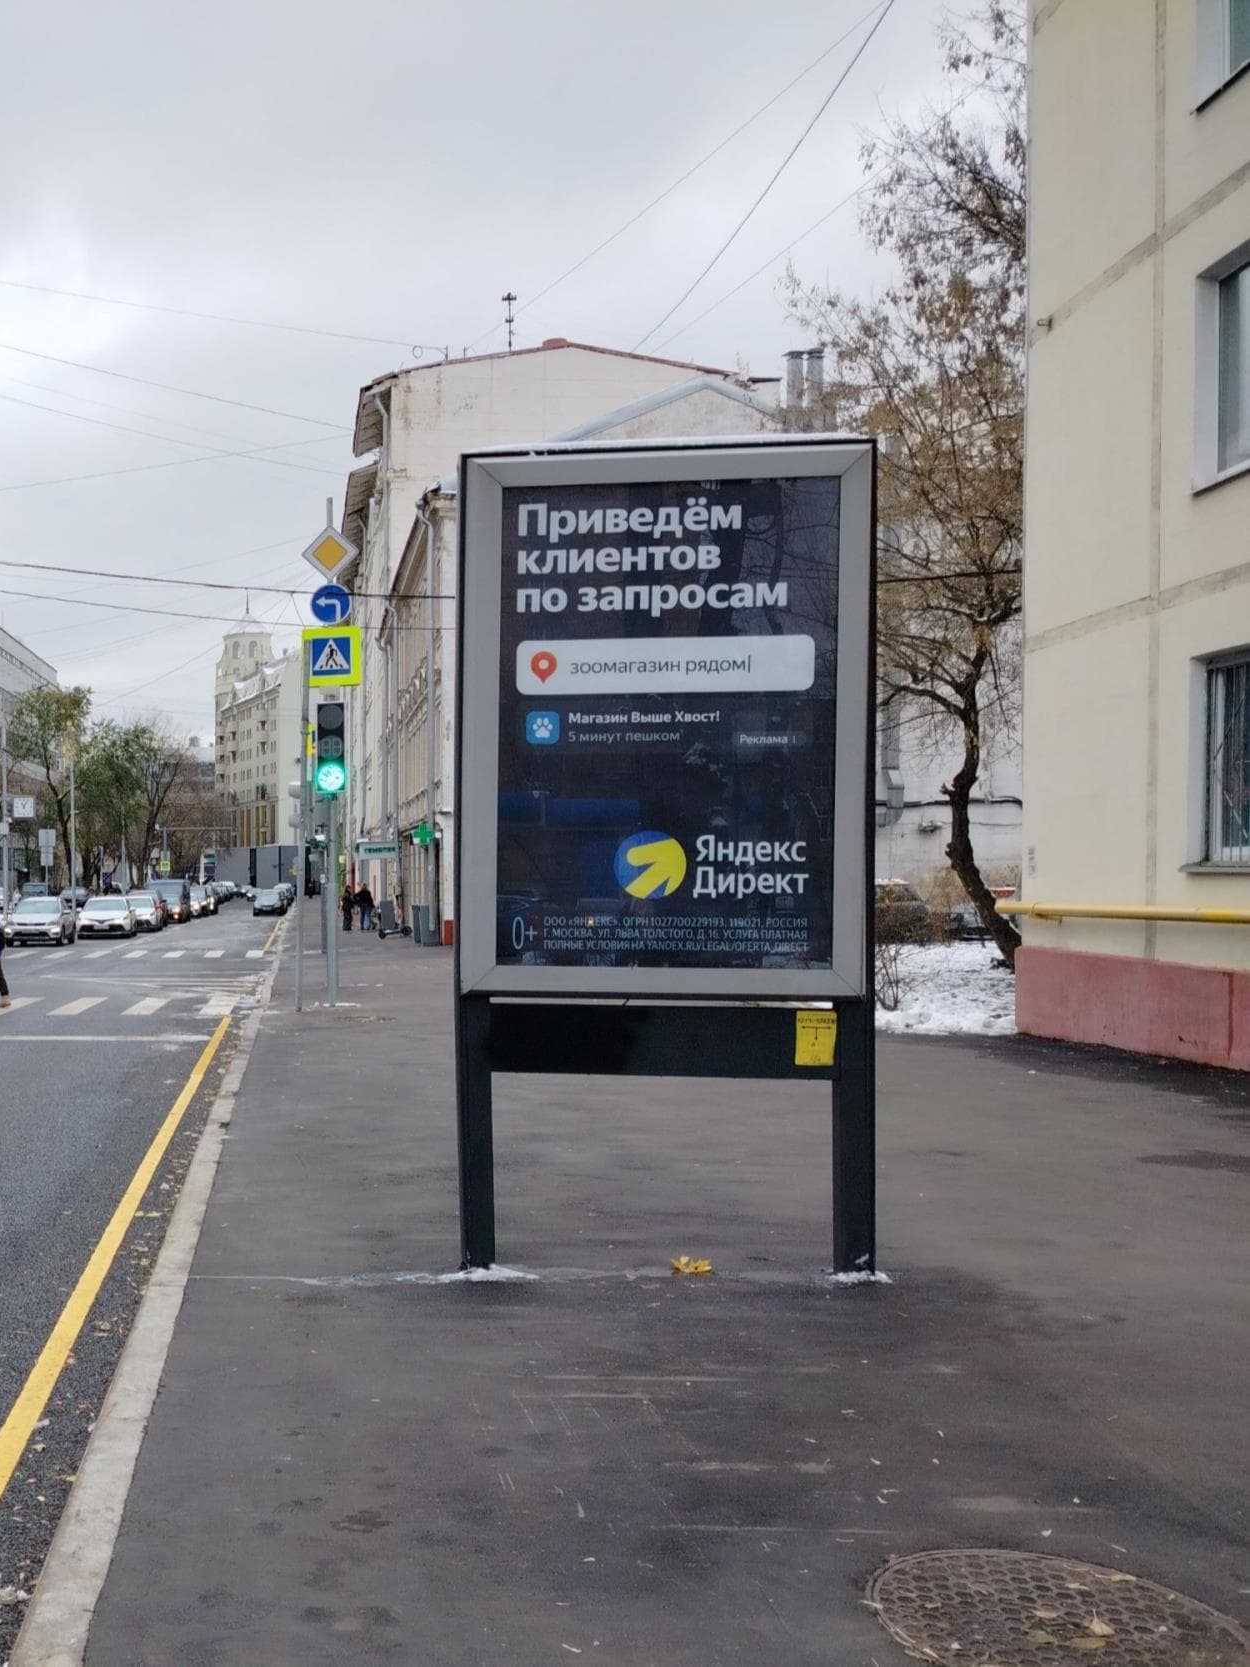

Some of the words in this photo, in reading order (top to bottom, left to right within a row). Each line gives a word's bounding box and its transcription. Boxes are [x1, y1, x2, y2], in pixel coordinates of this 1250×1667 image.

[518, 497, 742, 543] Приведём
[518, 545, 722, 575] клиентов
[517, 588, 568, 613] по
[577, 582, 788, 617] запросам
[570, 660, 681, 674] зоомагазин
[568, 712, 628, 724] Магазин
[631, 711, 672, 723] Выше
[675, 711, 720, 722] Хвост!
[568, 732, 576, 742] 5
[579, 733, 621, 743] минут
[739, 734, 788, 745] Реклама
[695, 834, 807, 866] Яндекс
[692, 866, 809, 899] Директ
[543, 916, 566, 926] ООО
[766, 918, 808, 928] РОССИЯ
[512, 916, 538, 950] 0+
[615, 928, 640, 939] ЛЬВА
[723, 929, 759, 939] УСЛУГА
[761, 929, 808, 939] ПЛАТНАЯ
[543, 940, 584, 950] ПОЛНЫЕ
[586, 940, 631, 950] УСЛОВИЯ
